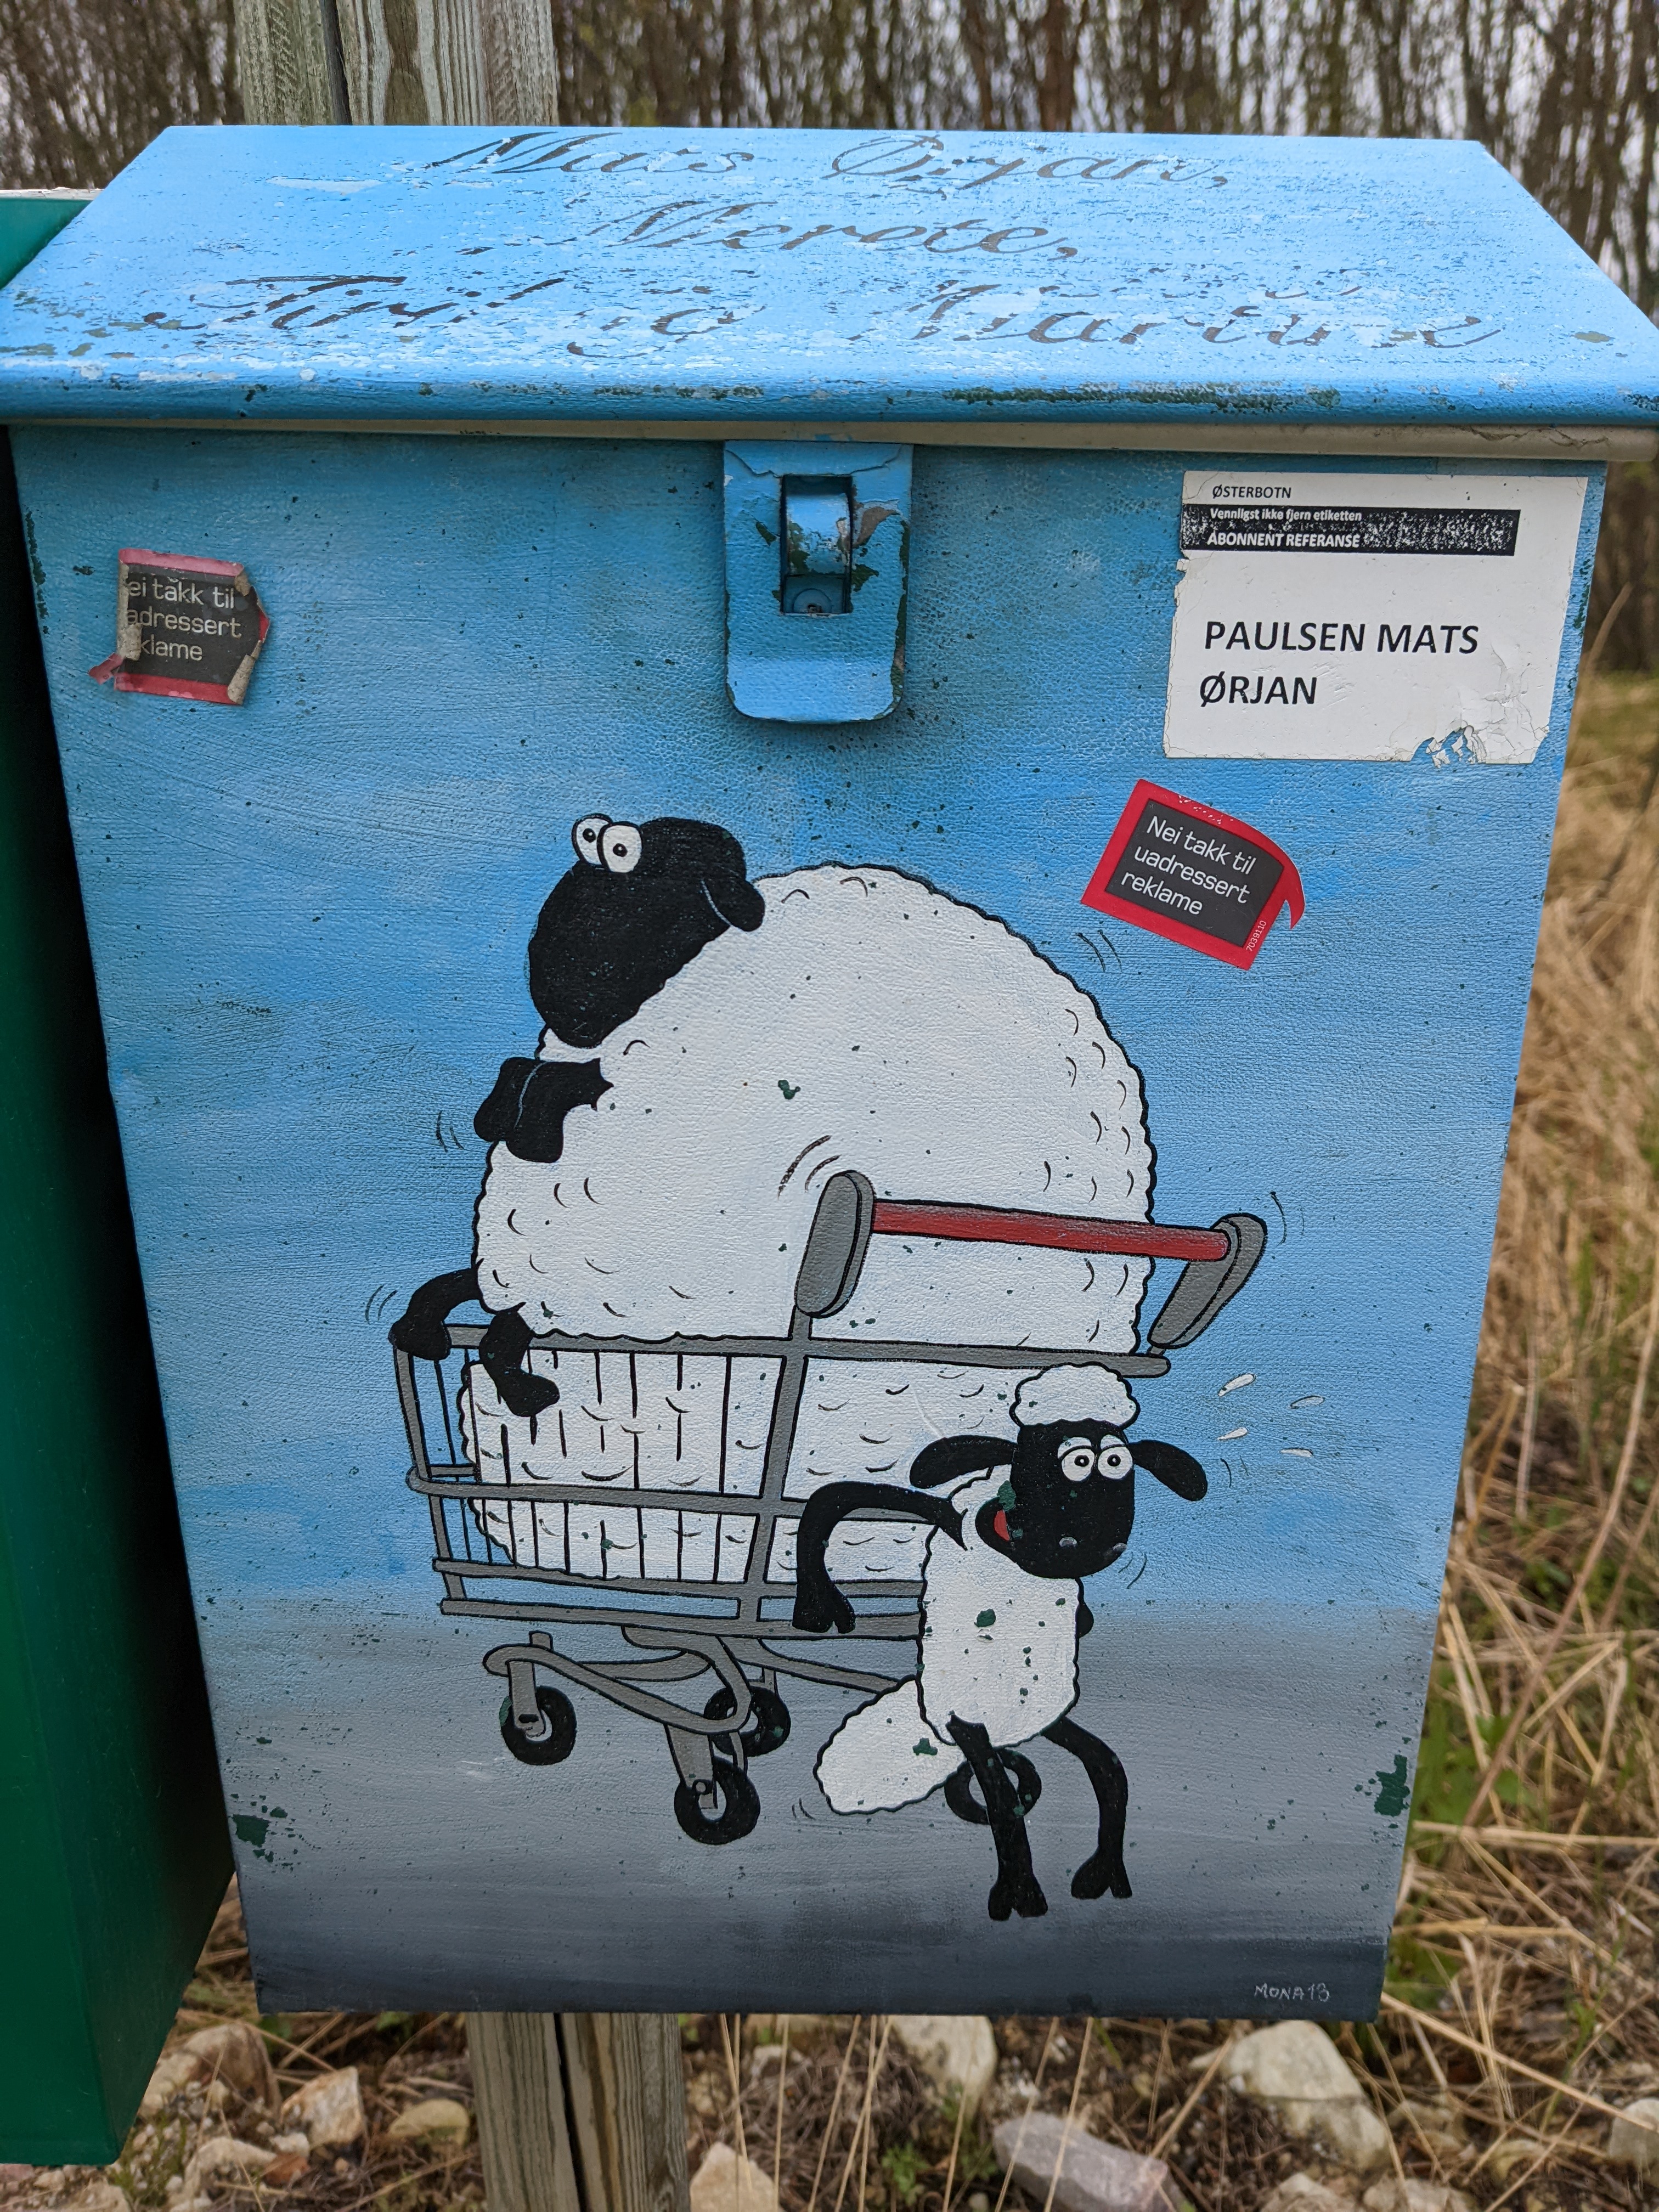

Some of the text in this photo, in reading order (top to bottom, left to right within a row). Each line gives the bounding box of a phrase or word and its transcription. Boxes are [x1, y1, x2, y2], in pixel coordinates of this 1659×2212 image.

[1212, 484, 1292, 499] ØSTERBOTN
[1261, 509, 1284, 521] ikke
[1286, 509, 1311, 522] fjern
[1313, 509, 1362, 521] etiketten
[1207, 531, 1361, 548] ABONNENT REFERANSE
[128, 577, 234, 609] ei takk til
[127, 605, 242, 639] adressert
[1204, 621, 1479, 654] PAULSEN MATS
[140, 634, 203, 661] klame
[1199, 671, 1317, 707] ØRJAN
[1146, 815, 1256, 875] Nei takk til
[1133, 845, 1250, 904] uadressert
[1120, 871, 1203, 915] reklame
[1246, 920, 1267, 952] 7039110
